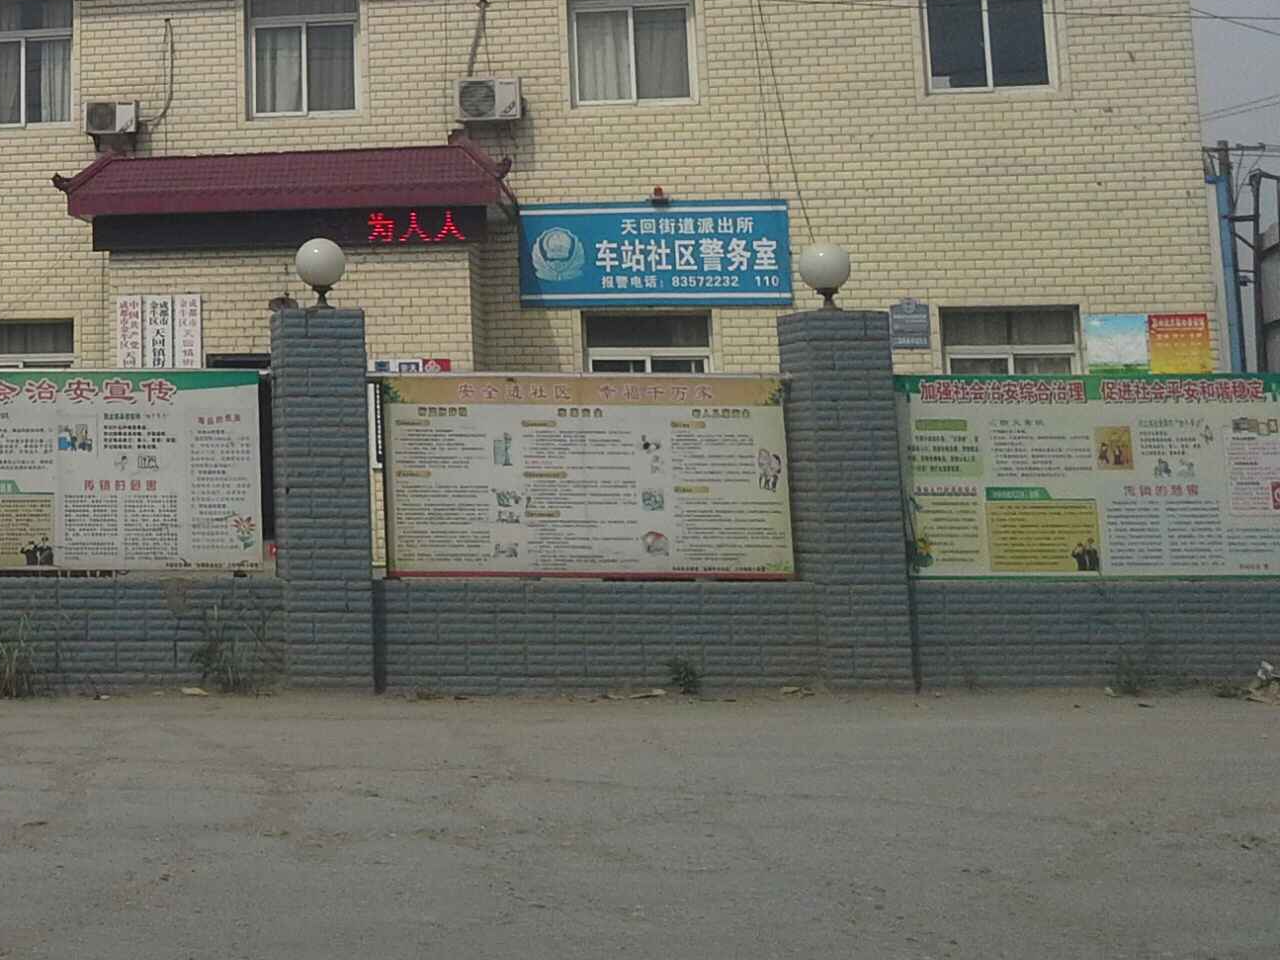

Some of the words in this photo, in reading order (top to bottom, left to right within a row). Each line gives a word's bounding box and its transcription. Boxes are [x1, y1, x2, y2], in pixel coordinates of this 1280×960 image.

[368, 212, 465, 241] 为人人
[621, 217, 754, 235] 天回街道派出所
[595, 239, 778, 272] 车站社区警务室
[671, 275, 740, 288] 83572232
[756, 276, 779, 287] 110
[920, 379, 1087, 403] 加强社会治安综合治理
[1101, 379, 1265, 402] 促进社会平安和谐稳定
